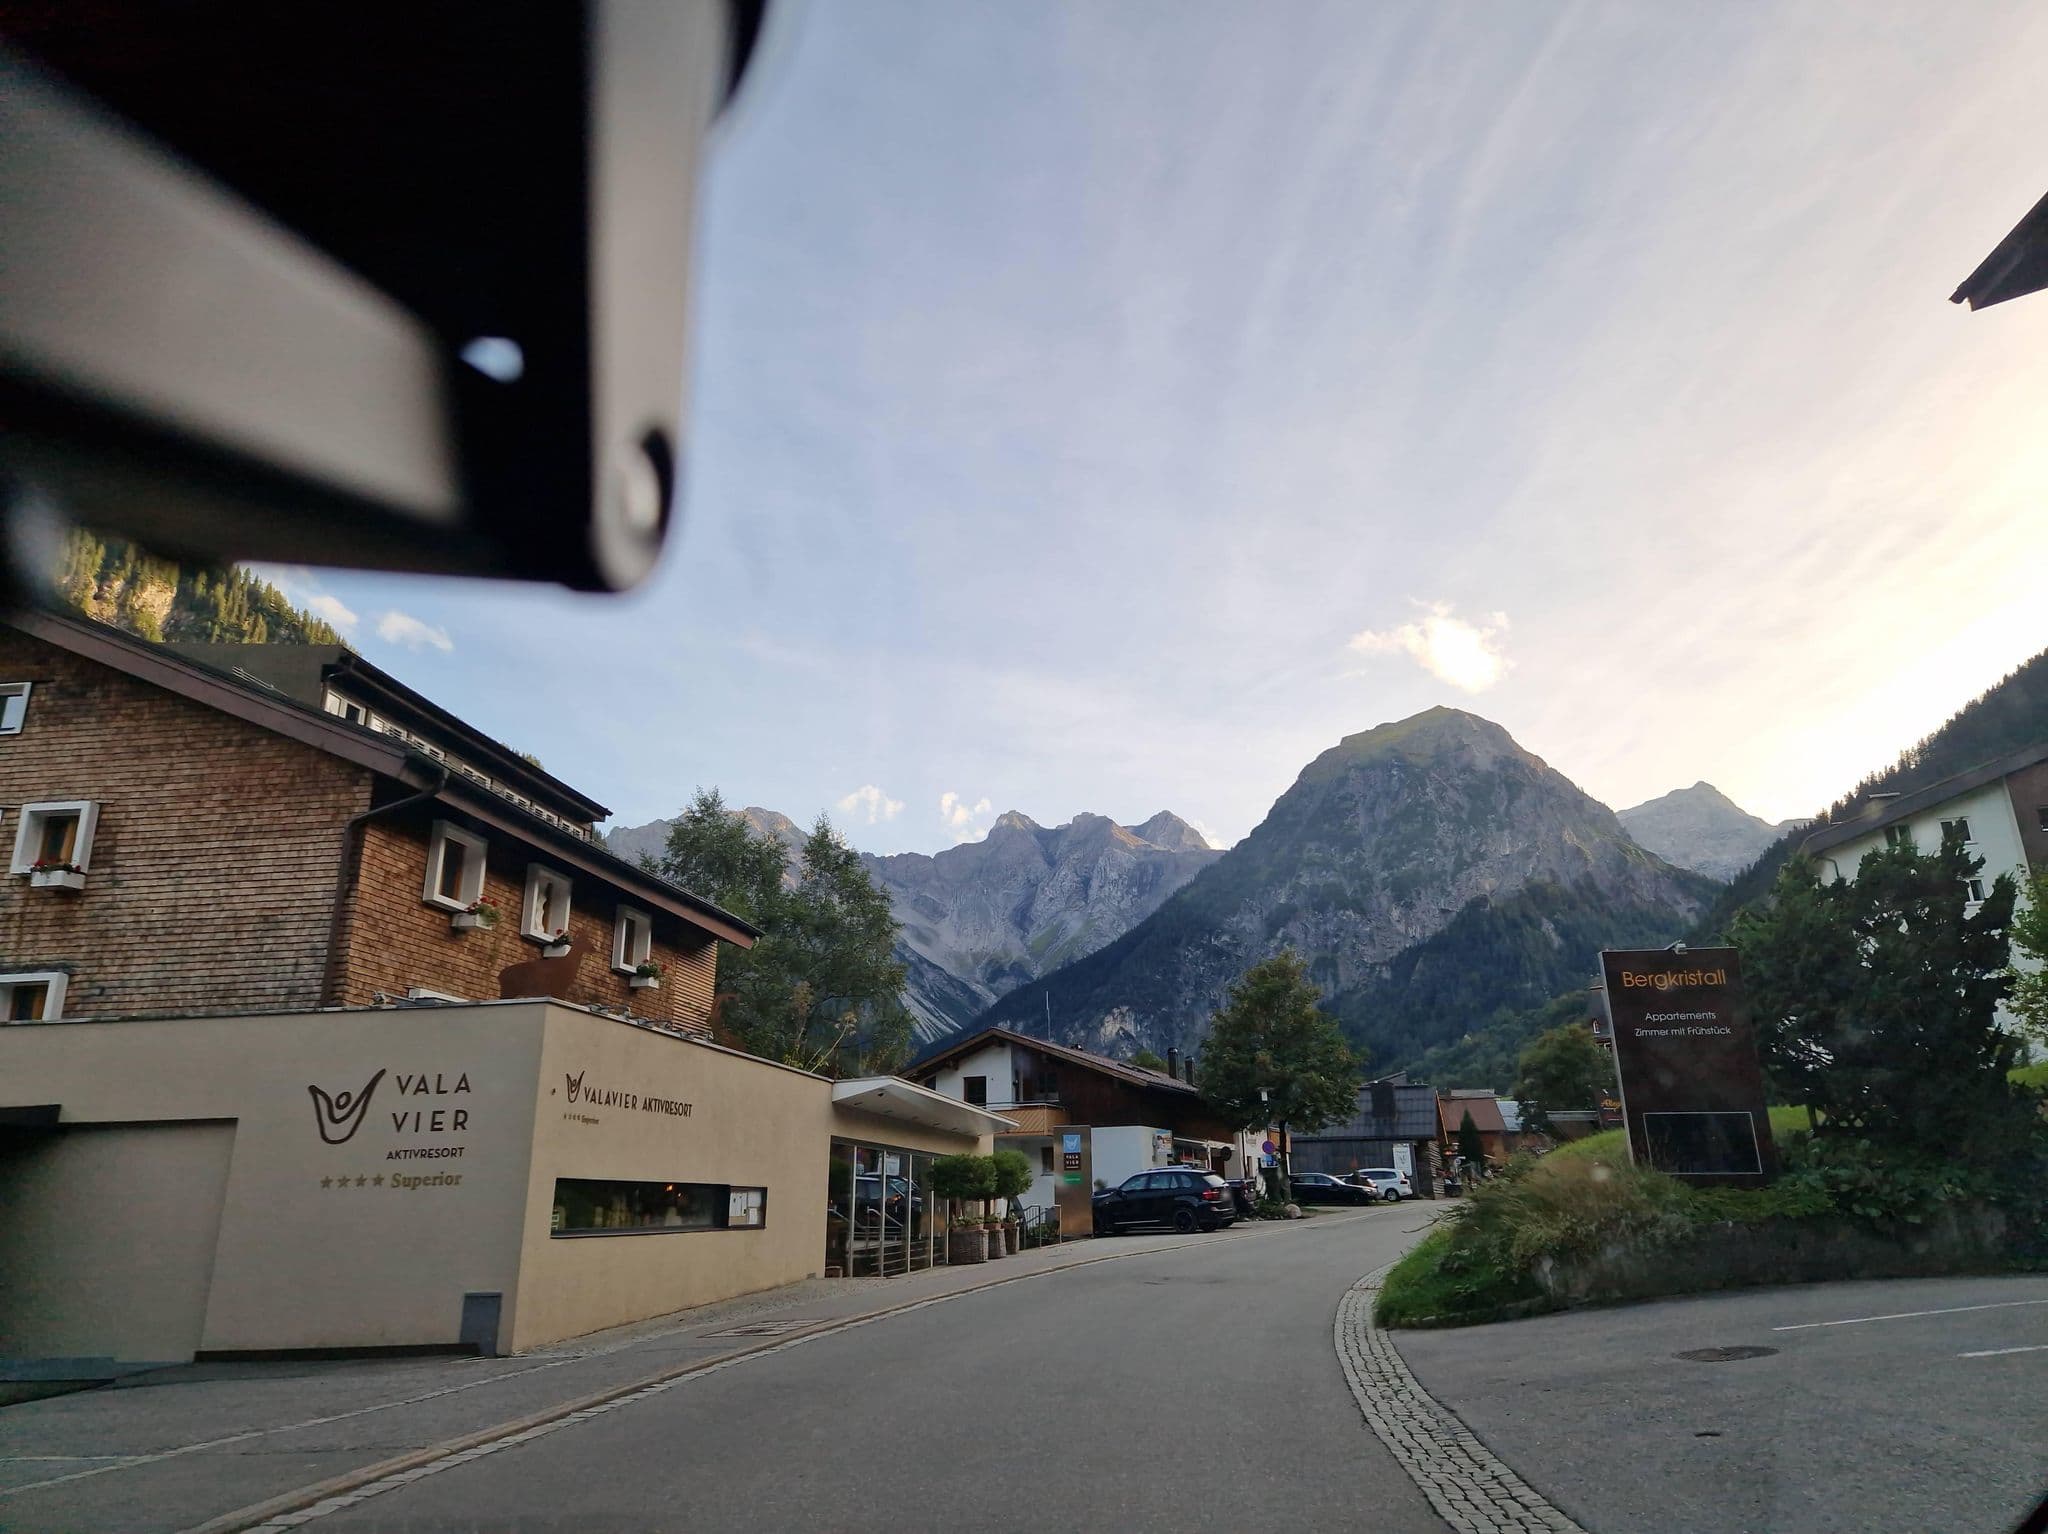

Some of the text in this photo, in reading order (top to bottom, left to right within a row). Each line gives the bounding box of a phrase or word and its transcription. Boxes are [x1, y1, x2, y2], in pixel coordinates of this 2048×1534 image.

[1622, 968, 1727, 991] Bergkristall
[1645, 1010, 1717, 1022] Appartements
[1634, 1025, 1732, 1038] Zimmer mit Frühstück
[396, 1072, 472, 1096] VALA
[584, 1086, 693, 1118] VALAVIER AKTIVRESORT
[392, 1109, 469, 1133] VIER
[386, 1147, 465, 1161] AKTIVRESORT
[390, 1171, 462, 1191] Superior
